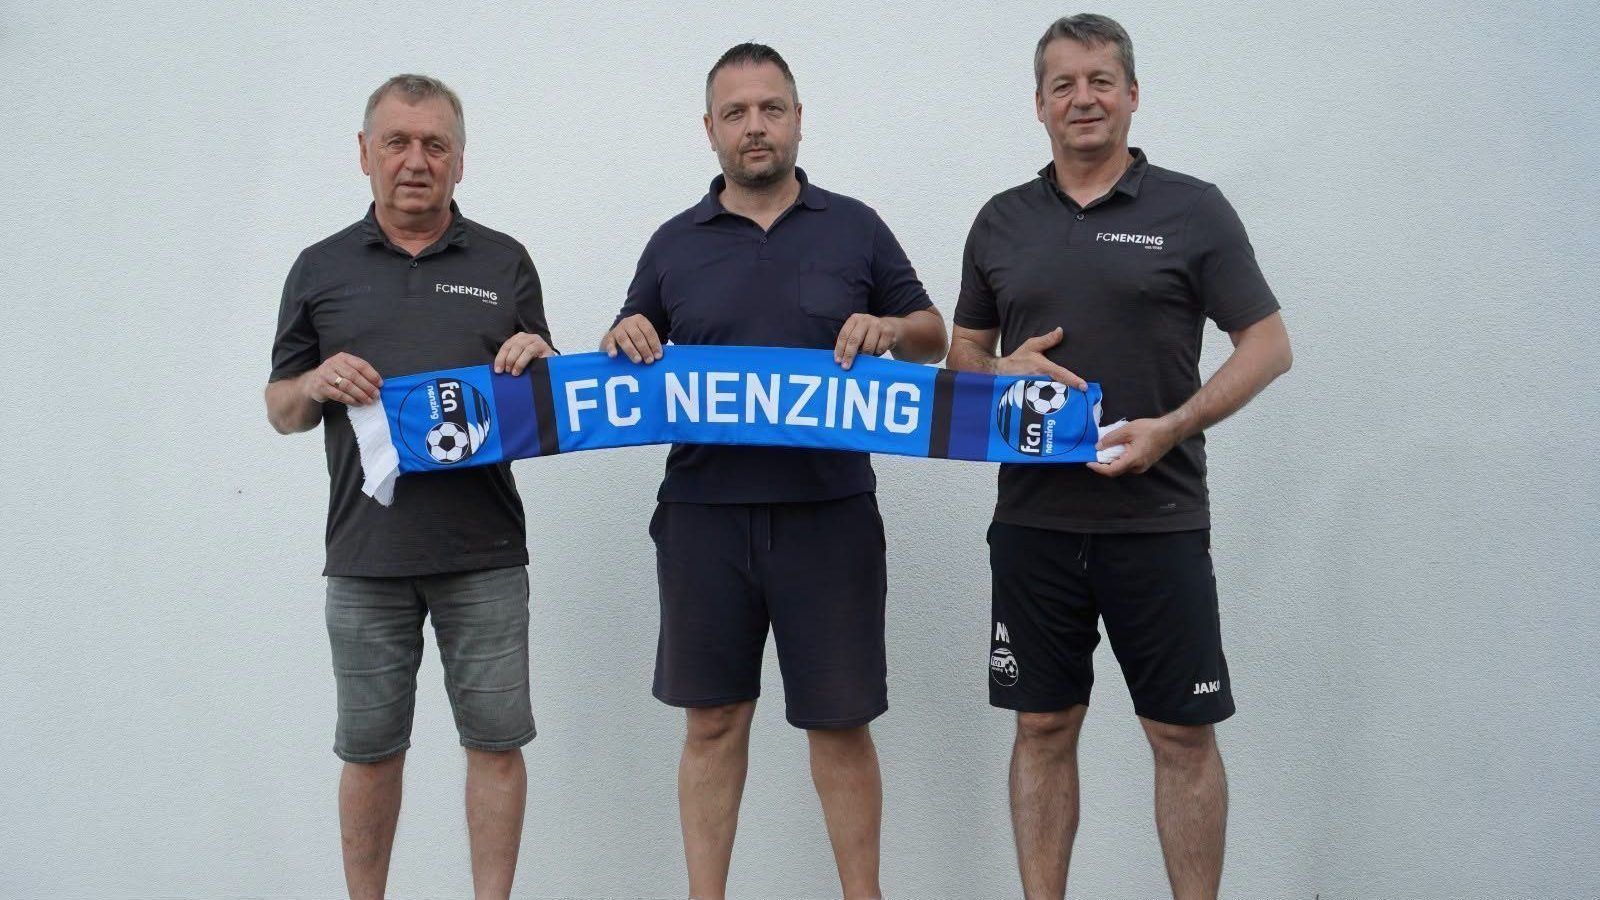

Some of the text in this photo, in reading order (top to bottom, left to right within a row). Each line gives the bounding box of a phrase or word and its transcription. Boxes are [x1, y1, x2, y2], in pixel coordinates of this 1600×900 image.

[427, 385, 440, 420] nenzing
[440, 381, 460, 412] fcn
[565, 372, 921, 434] FC NENZING
[1020, 423, 1042, 453] fcn
[1044, 419, 1056, 454] nenzing
